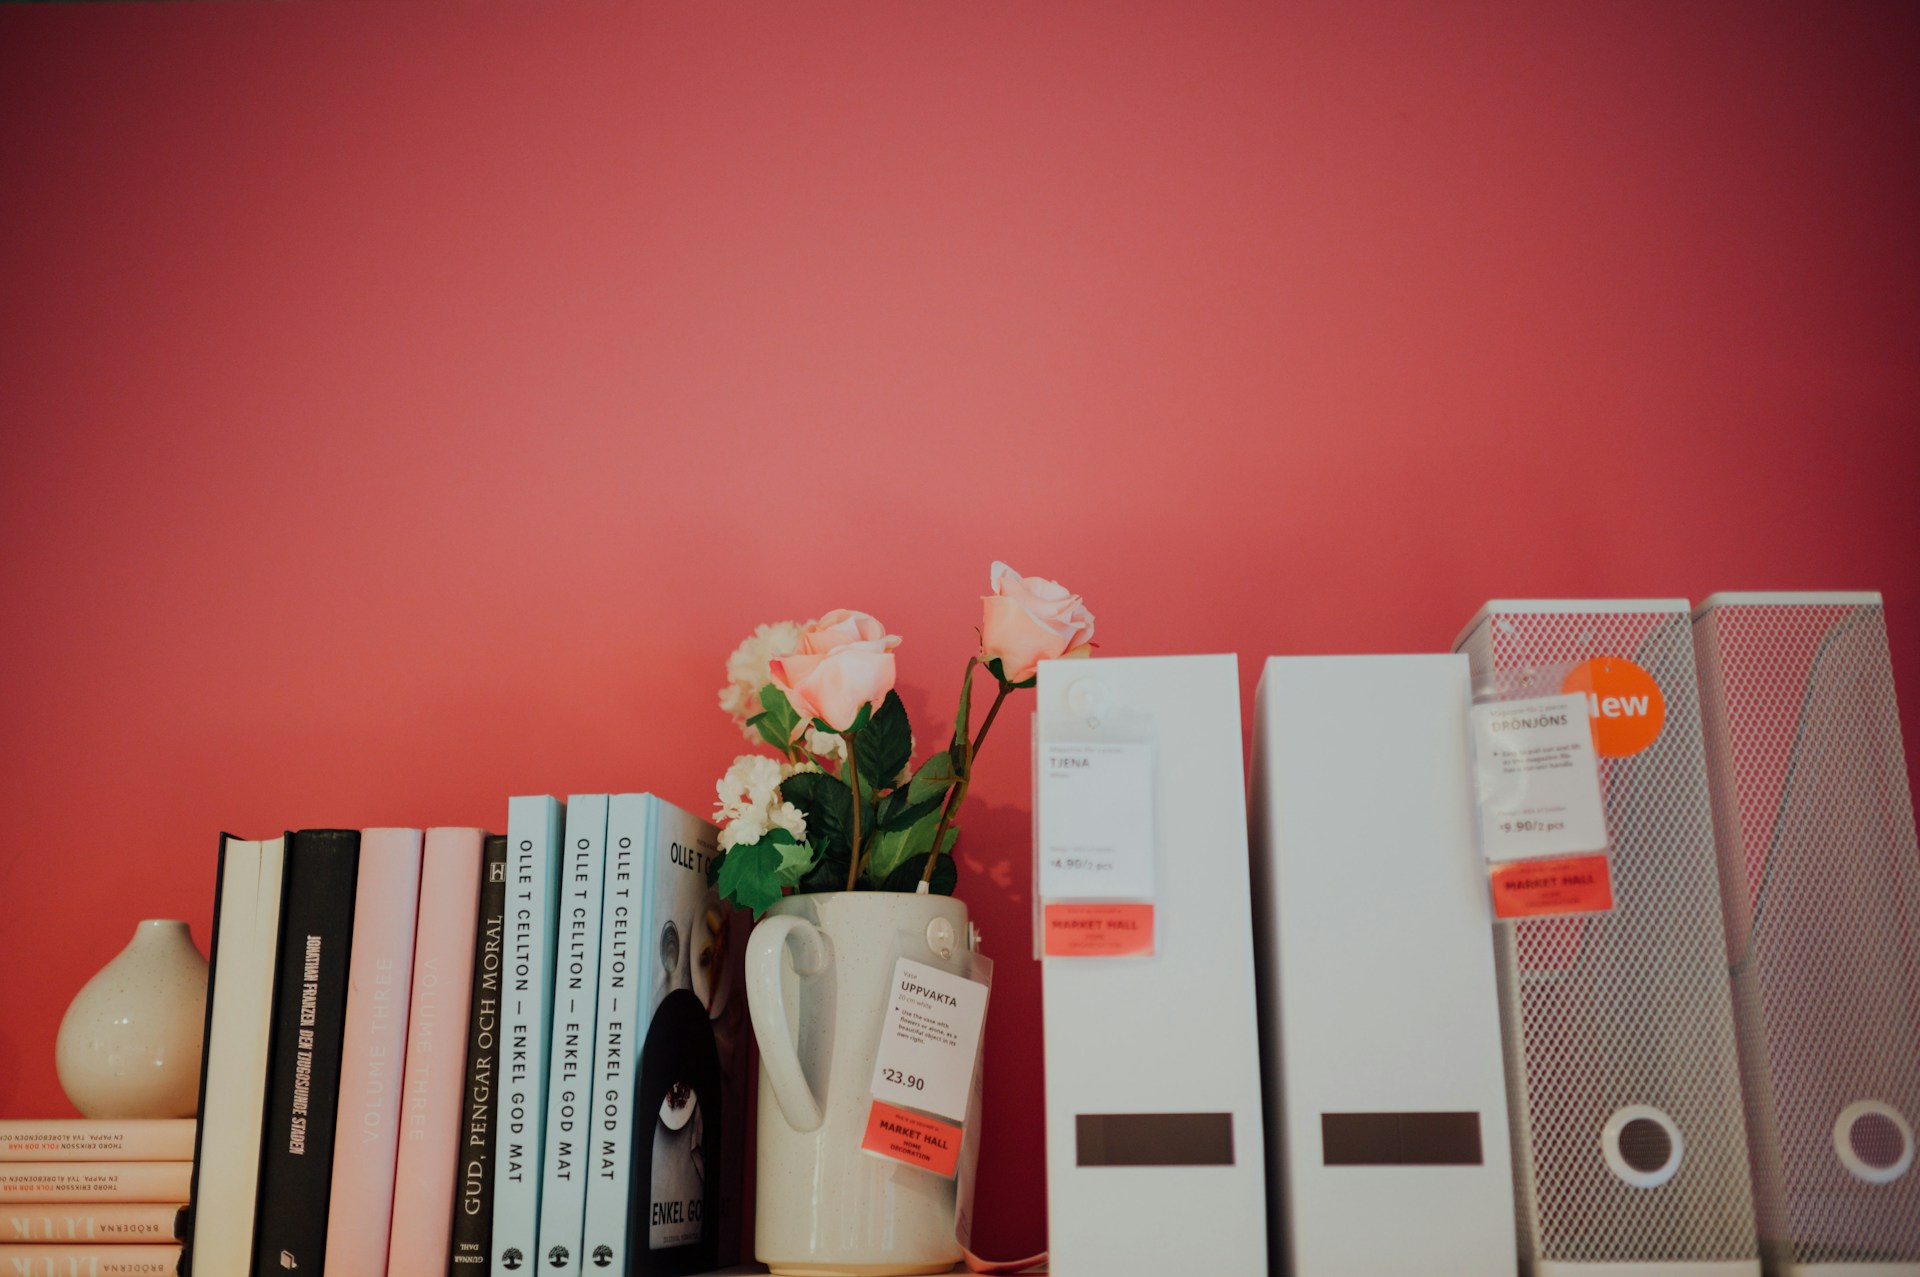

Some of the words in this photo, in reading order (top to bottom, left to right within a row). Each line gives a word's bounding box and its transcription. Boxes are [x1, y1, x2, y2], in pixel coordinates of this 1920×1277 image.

[1050, 758, 1090, 769] TJENA
[1547, 822, 1564, 832] pcs
[519, 840, 532, 883] OLLE
[575, 838, 589, 882] OLLE
[617, 837, 631, 880] OLLE
[670, 842, 694, 871] OLLE
[696, 852, 703, 873] T
[518, 892, 531, 900] T
[574, 890, 587, 899] T
[616, 889, 629, 898] T
[1562, 875, 1595, 886] HALL
[1052, 920, 1102, 930] MARKET
[1106, 920, 1138, 930] HALL
[303, 934, 322, 981] JONATHAN
[482, 915, 504, 991] MORAL
[516, 909, 530, 991] CELLTON
[569, 908, 586, 989] CELLTON
[611, 906, 628, 988] CELLTON
[901, 981, 957, 1008] UPPVAKTA
[903, 971, 918, 980] Vase
[300, 983, 318, 1027] FRANZEN
[371, 959, 393, 1034] THREE
[417, 957, 439, 1053] VOLUME
[917, 999, 932, 1009] white
[298, 1029, 314, 1050] DEN
[478, 999, 496, 1050] OCH
[512, 1025, 527, 1084] ENKEL
[563, 1023, 579, 1082] ENKEL
[606, 1022, 622, 1080] ENKEL
[292, 1051, 312, 1116] TJUGOSJUNDE
[363, 1046, 386, 1144] VOLUME
[883, 1068, 925, 1091] $23.90
[409, 1063, 430, 1141] THREE
[469, 1056, 492, 1147] PENGAR
[510, 1092, 525, 1134] GOD
[560, 1091, 575, 1132] GOD
[603, 1090, 618, 1131] GOD
[288, 1117, 307, 1156] STADEN
[880, 1120, 922, 1140] MARKET
[924, 1134, 948, 1150] HALL
[890, 1144, 931, 1161] DECORATION
[903, 1140, 921, 1150] HOME
[508, 1143, 523, 1183] MAT
[557, 1141, 572, 1181] MAT
[601, 1140, 616, 1180] MAT
[464, 1154, 487, 1215] GUD,
[100, 1224, 159, 1234] BRÖDERNA
[652, 1201, 684, 1226] ENKEL
[687, 1199, 704, 1222] GO
[454, 1255, 484, 1264] GUNNAR
[460, 1243, 479, 1251] DAHL
[103, 1264, 164, 1274] BRÖDERNA
